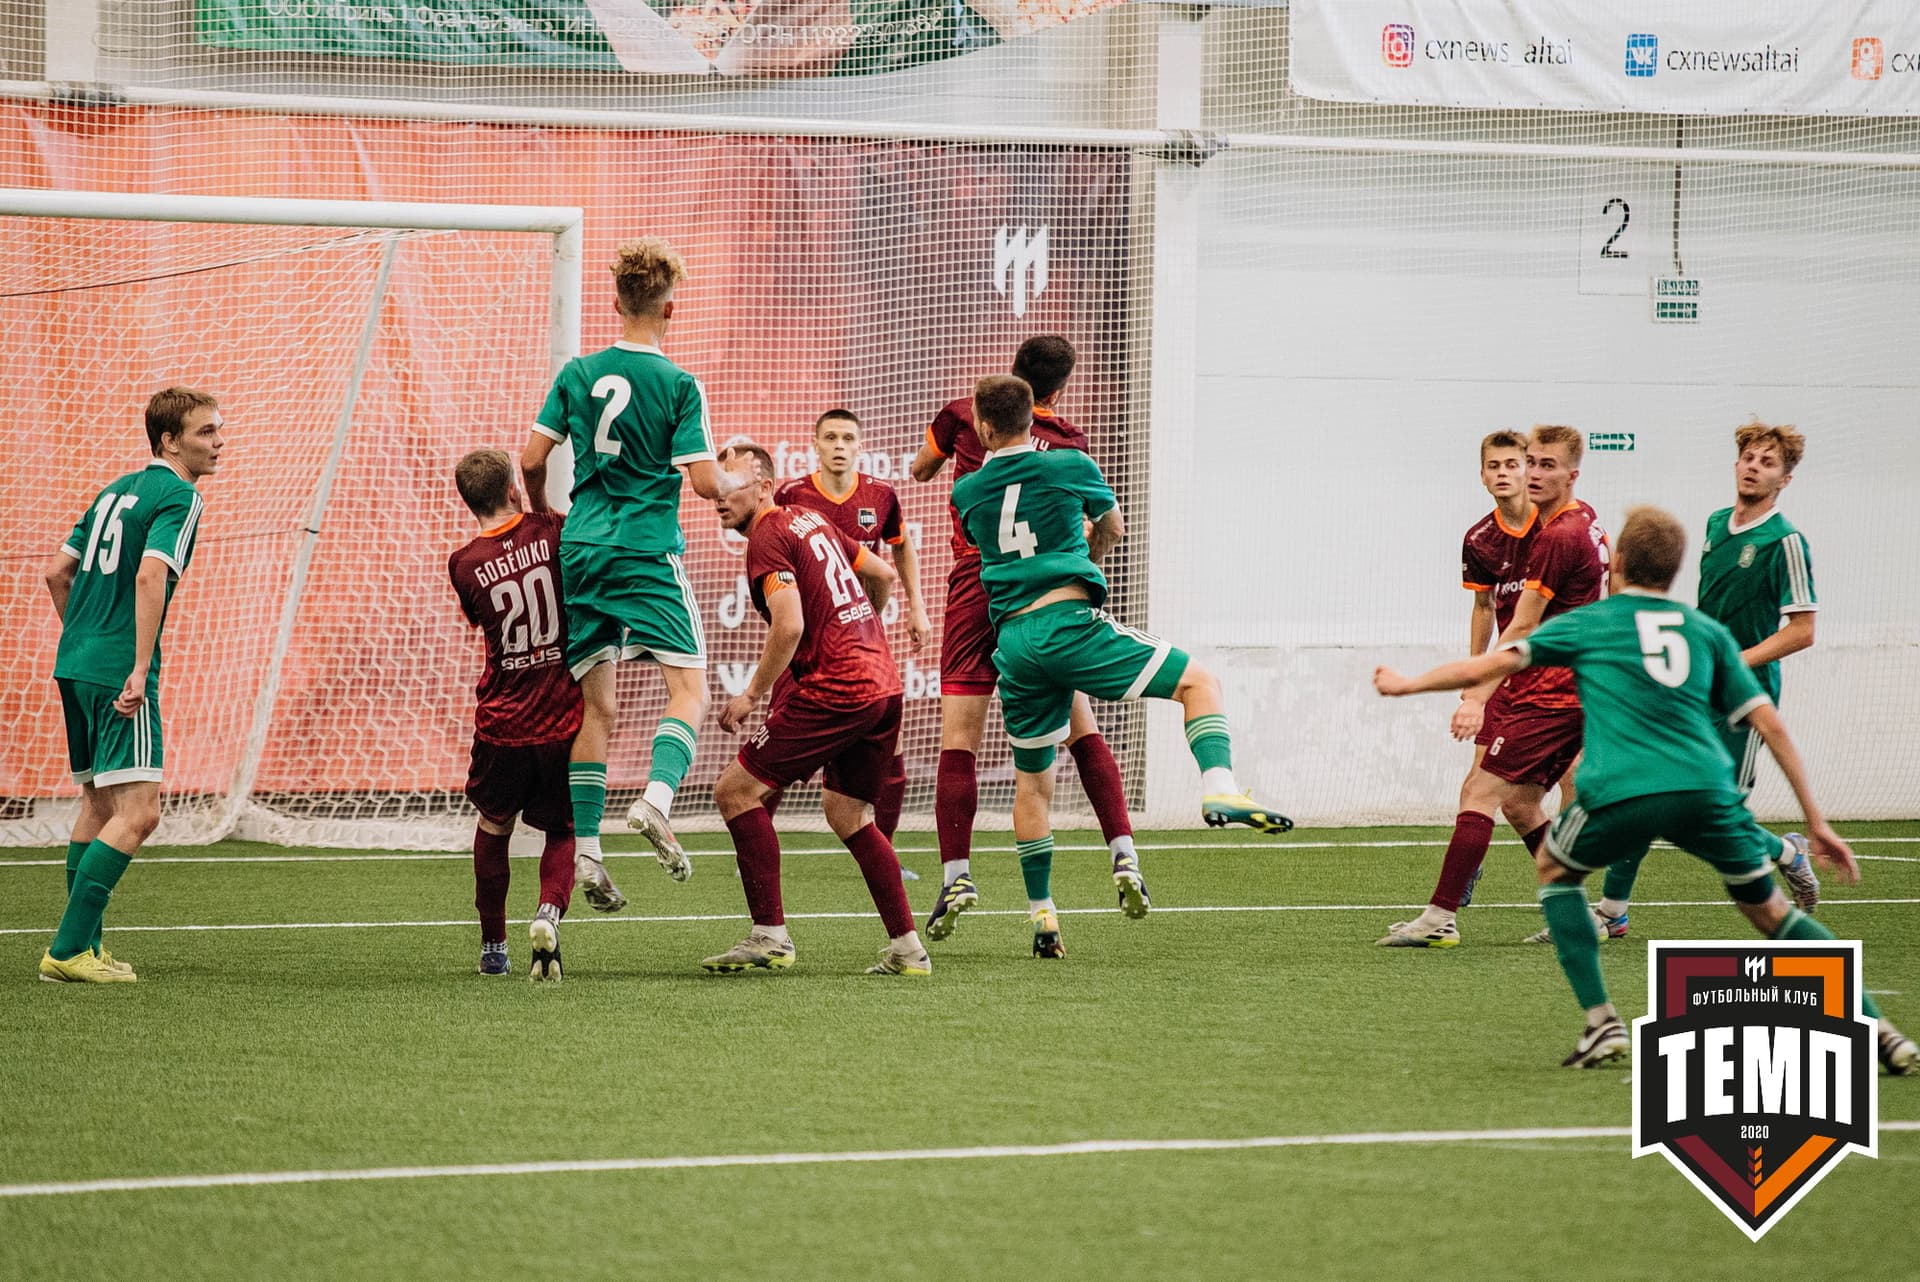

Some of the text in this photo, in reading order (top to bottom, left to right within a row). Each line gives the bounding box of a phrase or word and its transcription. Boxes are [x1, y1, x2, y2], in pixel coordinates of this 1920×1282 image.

[1425, 36, 1574, 67] cxnews_altai
[1666, 45, 1799, 72] cxnewsaltai
[1890, 53, 1920, 73] cx
[1601, 198, 1631, 258] 2
[591, 374, 632, 456] 2
[82, 493, 139, 575] 15
[998, 483, 1038, 559] 4
[474, 539, 550, 588] БОБЕШКО
[809, 532, 866, 608] 24
[490, 565, 560, 655] 20
[501, 647, 562, 671] SEUS
[1634, 611, 1691, 688] 5
[751, 724, 770, 750] 24
[1489, 736, 1505, 756] 6
